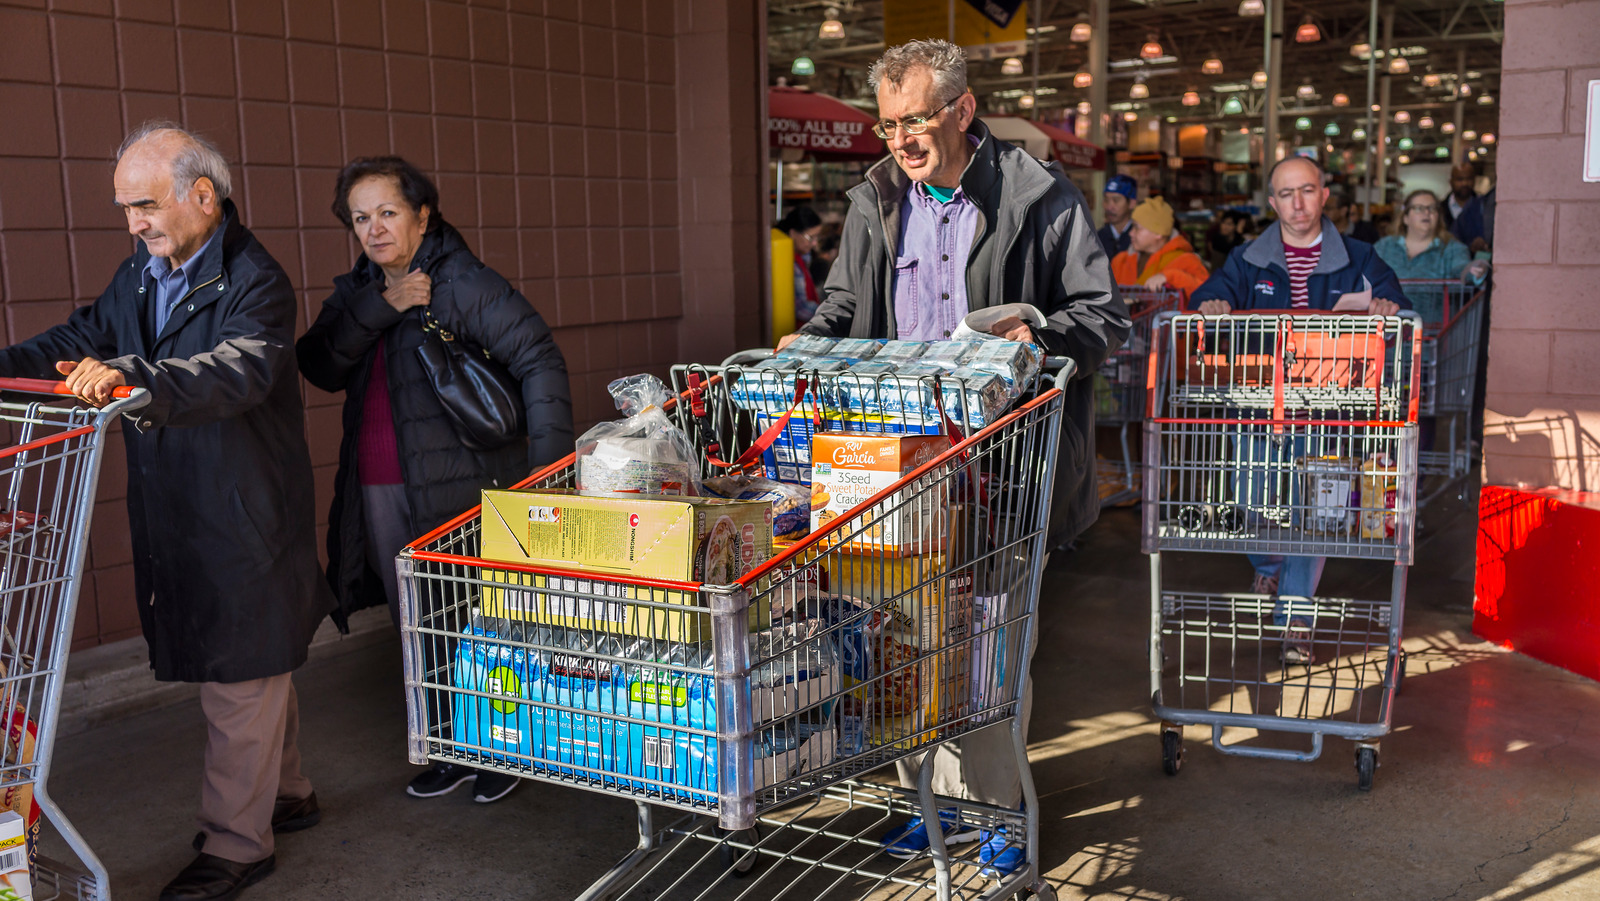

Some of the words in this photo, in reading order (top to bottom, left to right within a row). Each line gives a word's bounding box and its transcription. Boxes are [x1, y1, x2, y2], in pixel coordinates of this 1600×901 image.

[803, 120, 829, 133] ALL
[833, 121, 864, 135] BEEF
[777, 133, 808, 146] HOT
[810, 134, 852, 149] DOGS
[832, 446, 876, 465] Garcia
[826, 482, 851, 494] Sweet
[536, 718, 550, 726] wih
[550, 720, 576, 730] mneras
[577, 722, 596, 733] aded
[607, 727, 624, 737] tate
